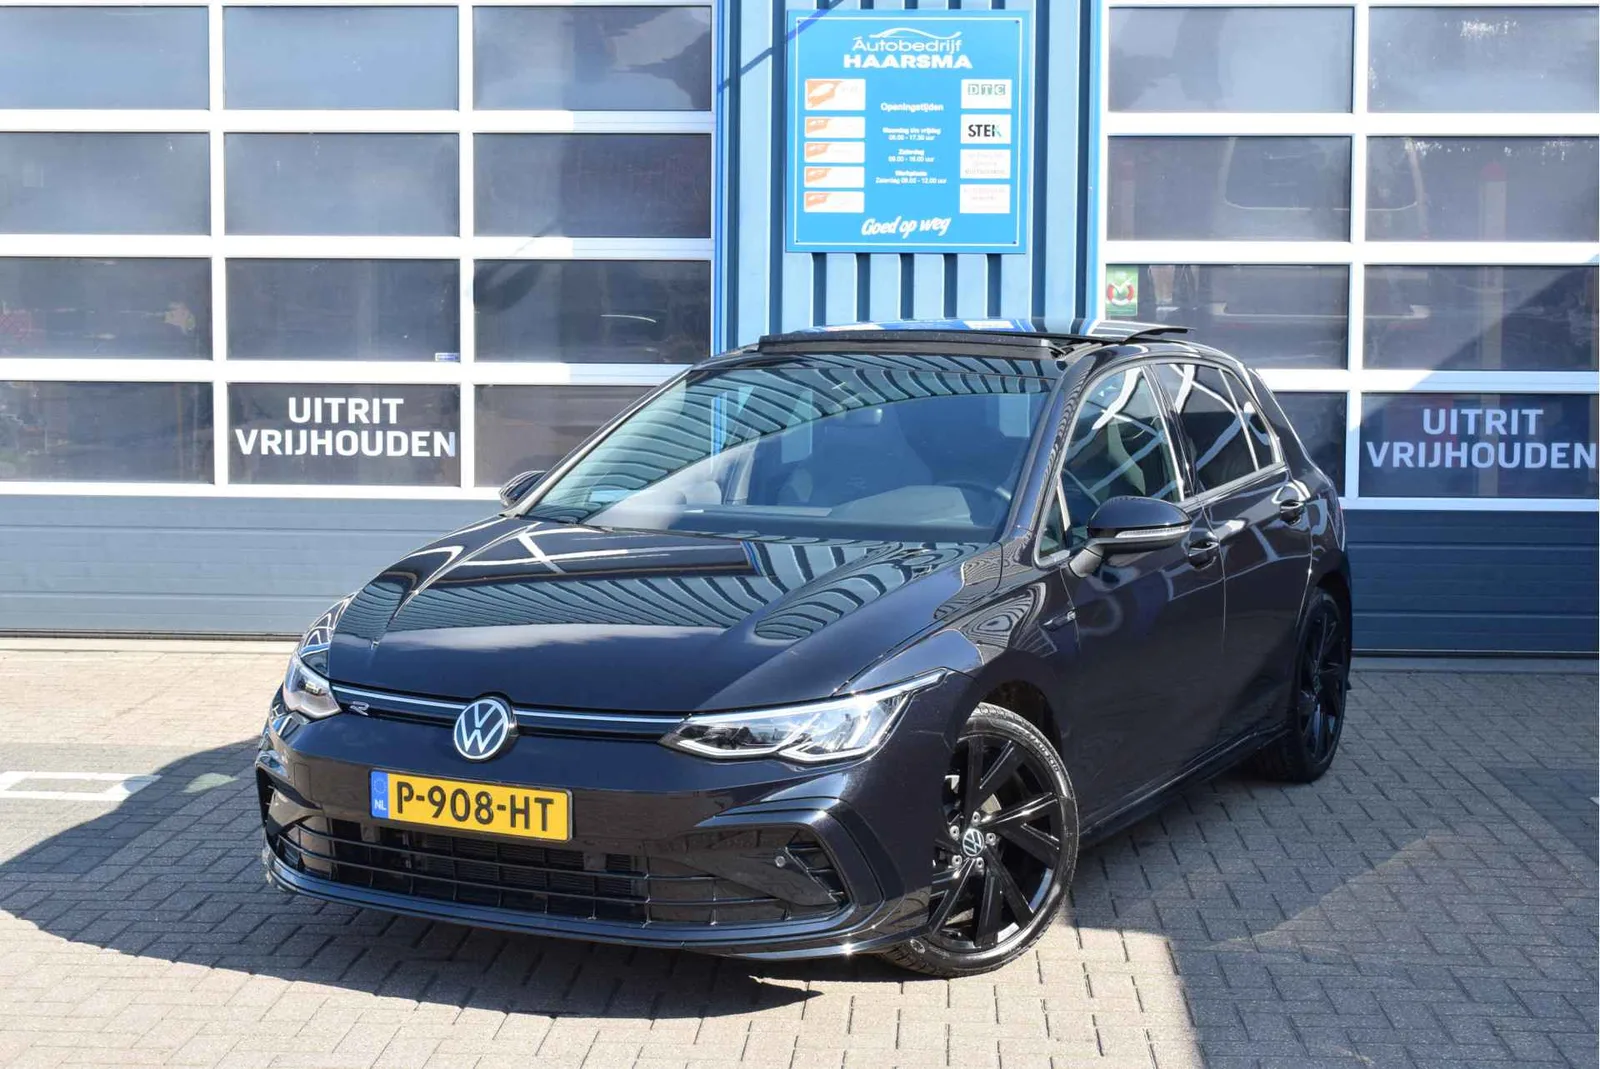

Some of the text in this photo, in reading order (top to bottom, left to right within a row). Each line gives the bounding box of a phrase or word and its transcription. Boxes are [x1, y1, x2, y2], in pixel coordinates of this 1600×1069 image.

[843, 54, 973, 69] HAARSMA
[968, 84, 1006, 96] DTC
[880, 103, 944, 112] Openingstijden
[861, 216, 952, 240] Goed op weg
[288, 397, 404, 424] UITRIT
[1423, 408, 1544, 436] UITRIT
[235, 428, 456, 457] VRIJHOUDEN
[1366, 441, 1597, 469] VRIJHOUDEN
[374, 799, 387, 811] NL
[396, 781, 554, 832] P-908-HT
